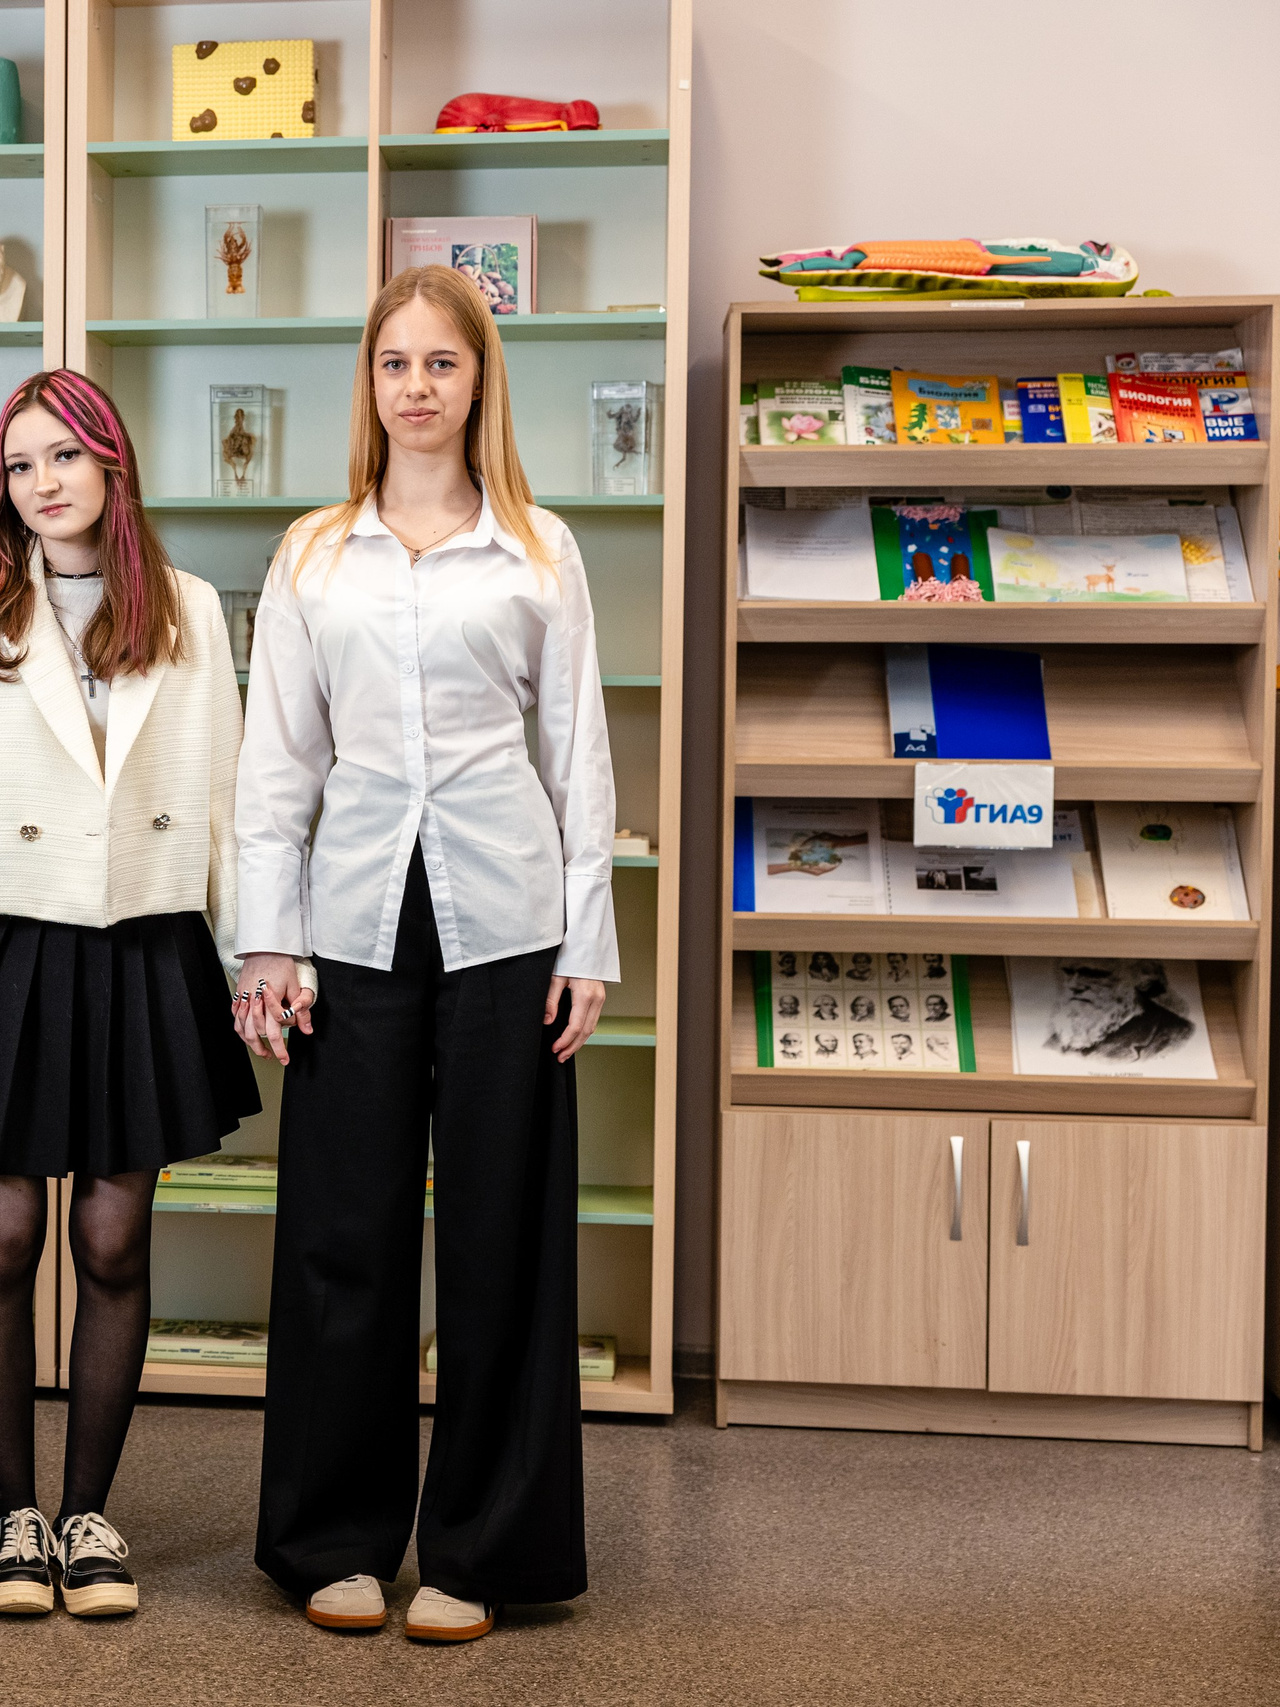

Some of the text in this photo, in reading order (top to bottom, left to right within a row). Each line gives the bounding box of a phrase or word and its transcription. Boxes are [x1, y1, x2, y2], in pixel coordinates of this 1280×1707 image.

[918, 386, 980, 398] Биология
[1119, 389, 1192, 407] БИОЛОГИЯ
[974, 804, 1043, 824] ГИА9
